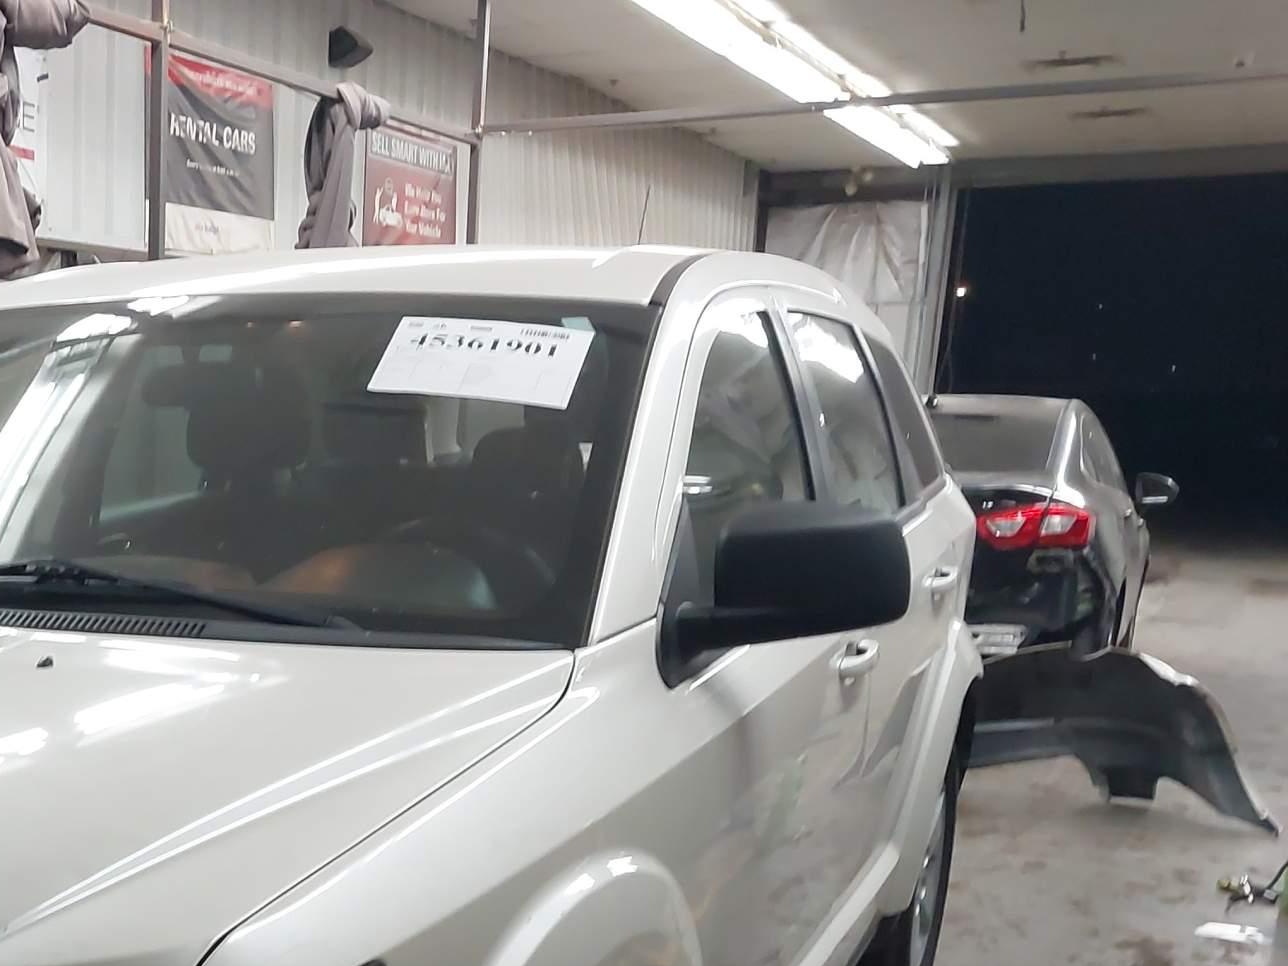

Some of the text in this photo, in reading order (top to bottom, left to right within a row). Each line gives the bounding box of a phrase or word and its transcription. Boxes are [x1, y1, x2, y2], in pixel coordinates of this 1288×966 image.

[169, 112, 256, 155] RENTAL CARS
[372, 131, 390, 156] SELL
[391, 137, 418, 164] SMART
[418, 146, 439, 171] WITH
[410, 332, 558, 358] 45361901
